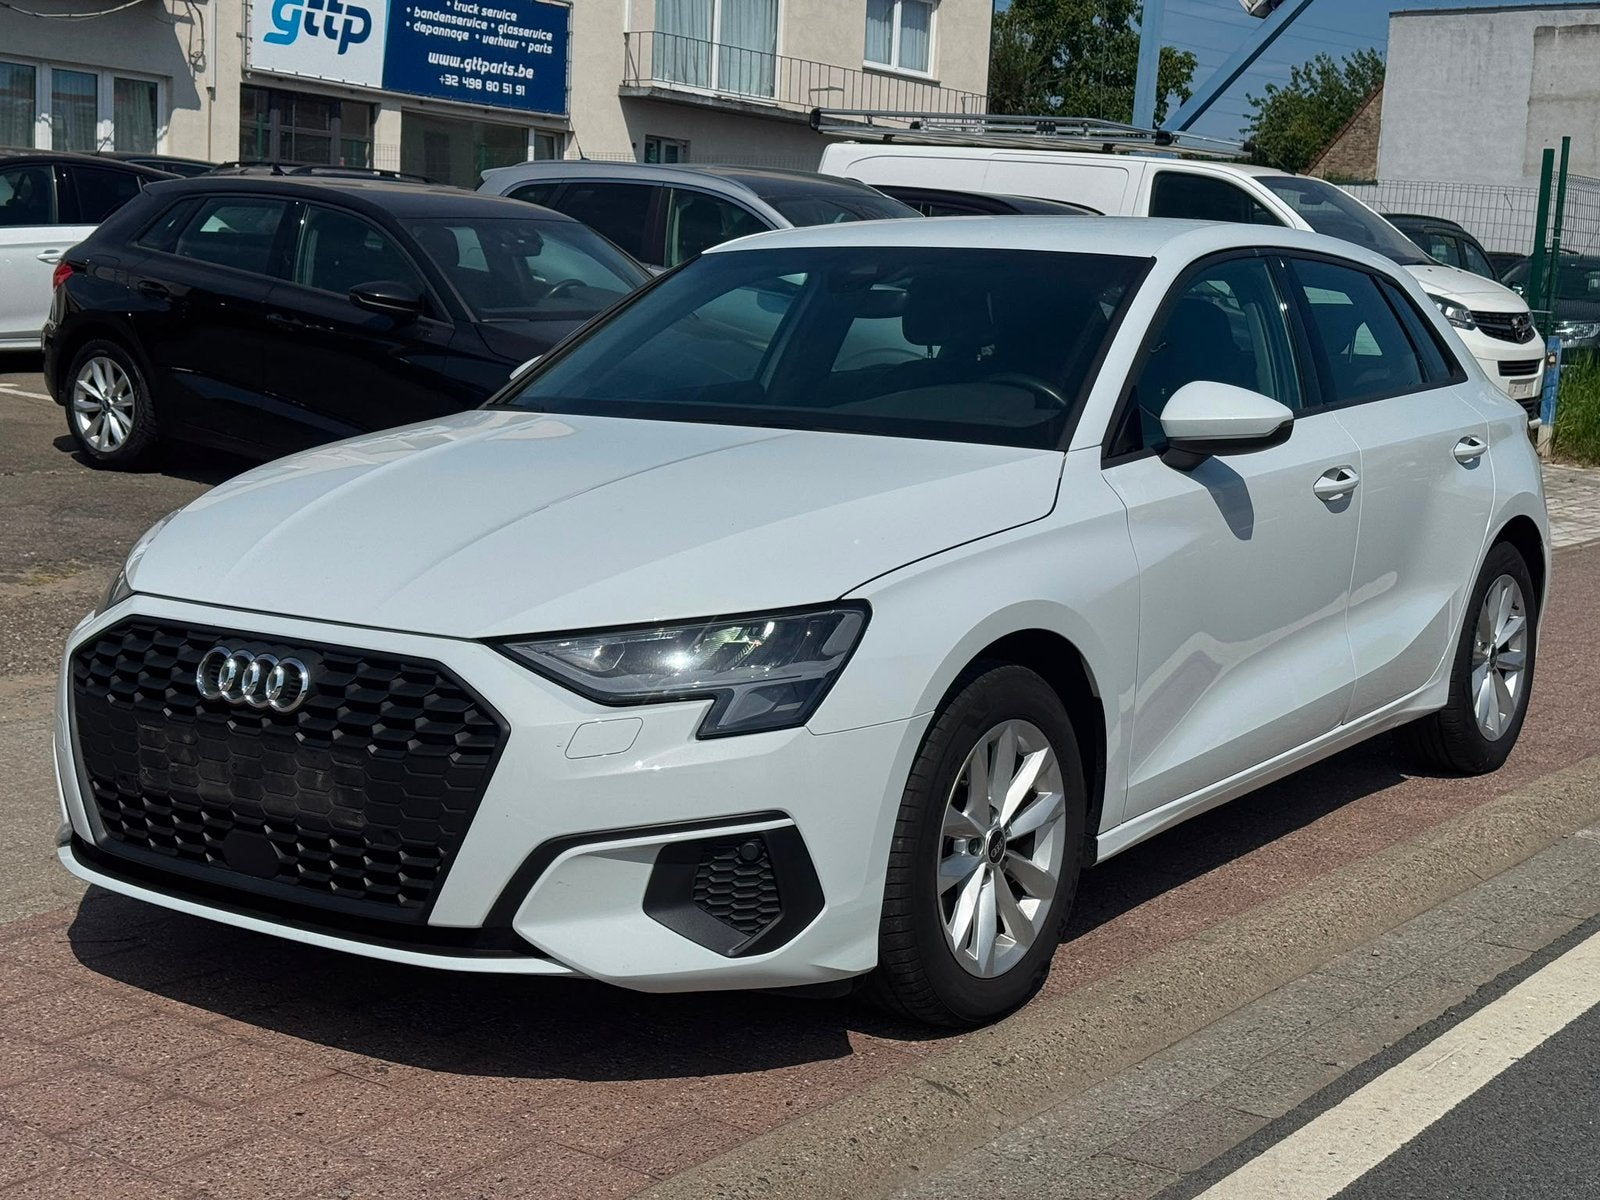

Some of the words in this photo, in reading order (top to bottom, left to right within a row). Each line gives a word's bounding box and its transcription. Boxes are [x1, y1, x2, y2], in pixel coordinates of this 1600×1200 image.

[414, 6, 488, 30] bandenservice
[498, 23, 553, 41] glasservice
[454, 1, 479, 15] truck
[481, 7, 518, 21] service
[413, 21, 469, 41] depannage
[482, 34, 519, 48] verhuur
[527, 41, 553, 54] parts
[428, 52, 534, 79] www.gttparts.be
[439, 74, 459, 85] +32
[462, 77, 482, 90] 498
[485, 80, 499, 92] 80
[502, 82, 512, 94] 51
[515, 84, 525, 96] 91
